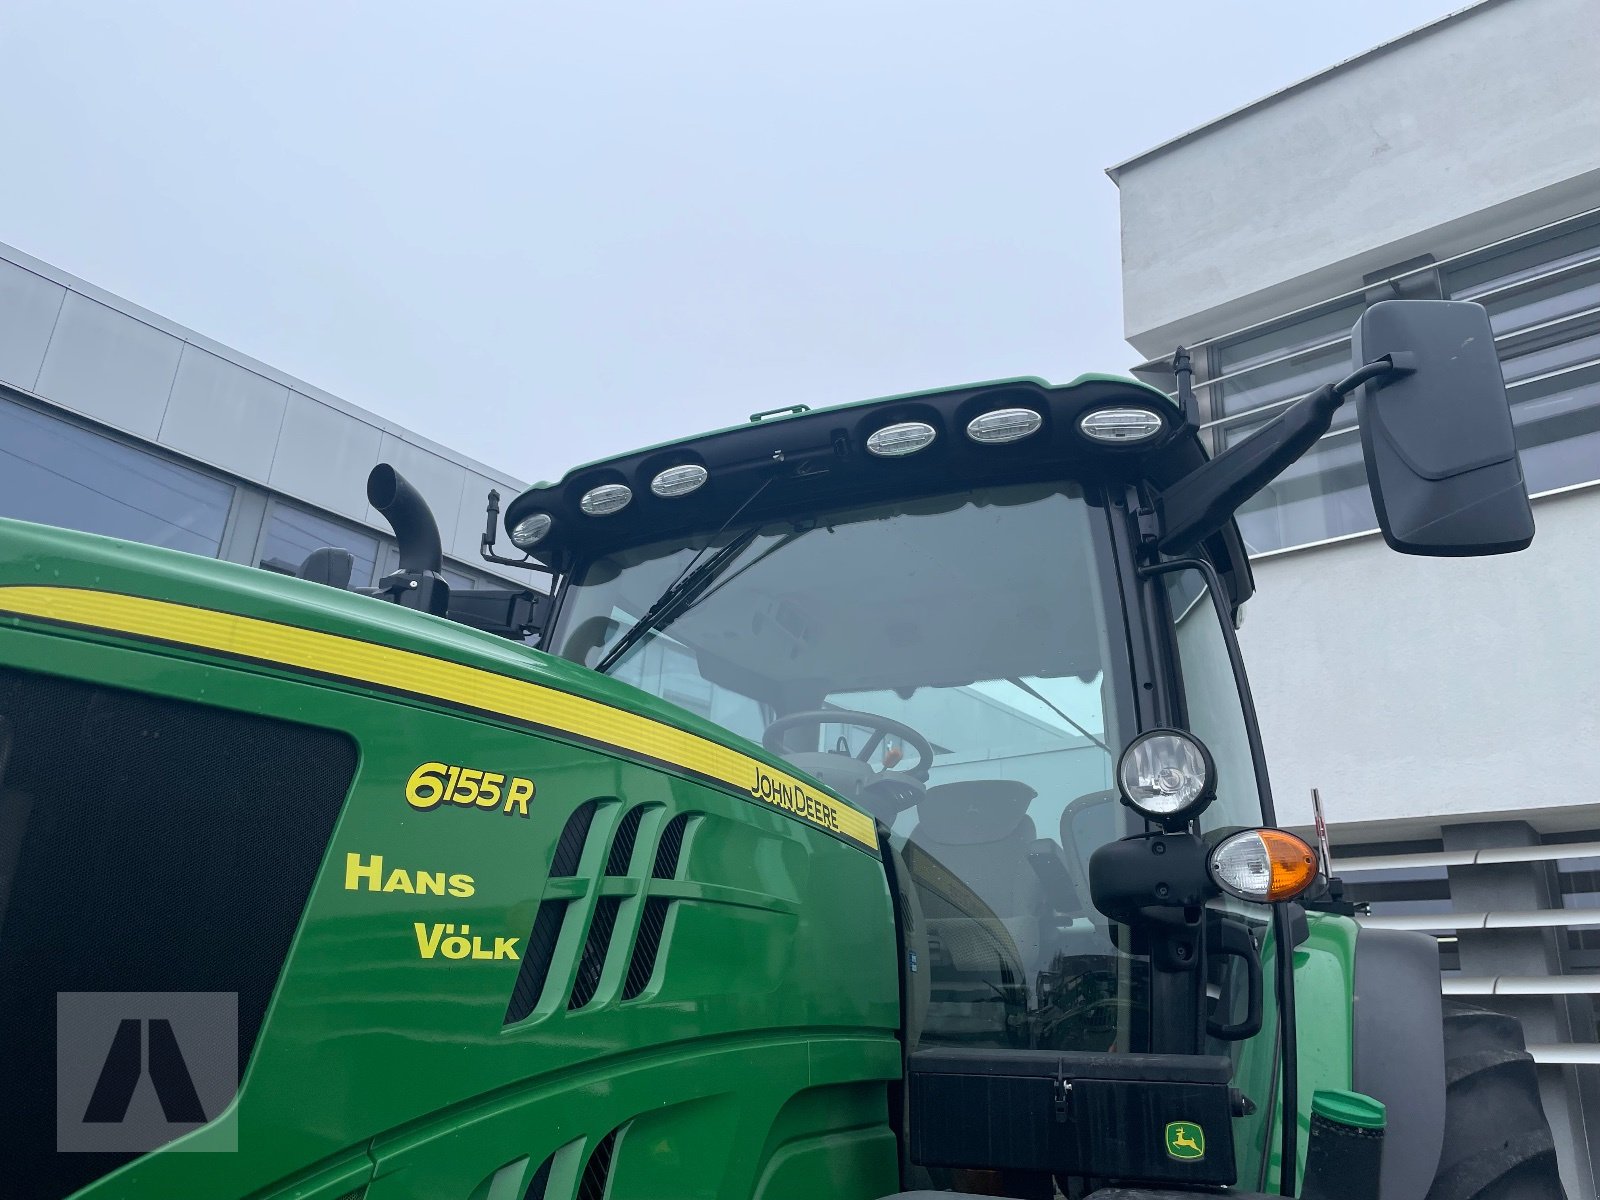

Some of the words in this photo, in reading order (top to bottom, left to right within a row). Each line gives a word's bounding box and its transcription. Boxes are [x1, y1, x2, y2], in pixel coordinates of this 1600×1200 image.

[751, 766, 794, 809] JOHN
[794, 784, 839, 831] DEERE
[344, 852, 475, 898] HANS
[414, 922, 519, 961] VÖLK
